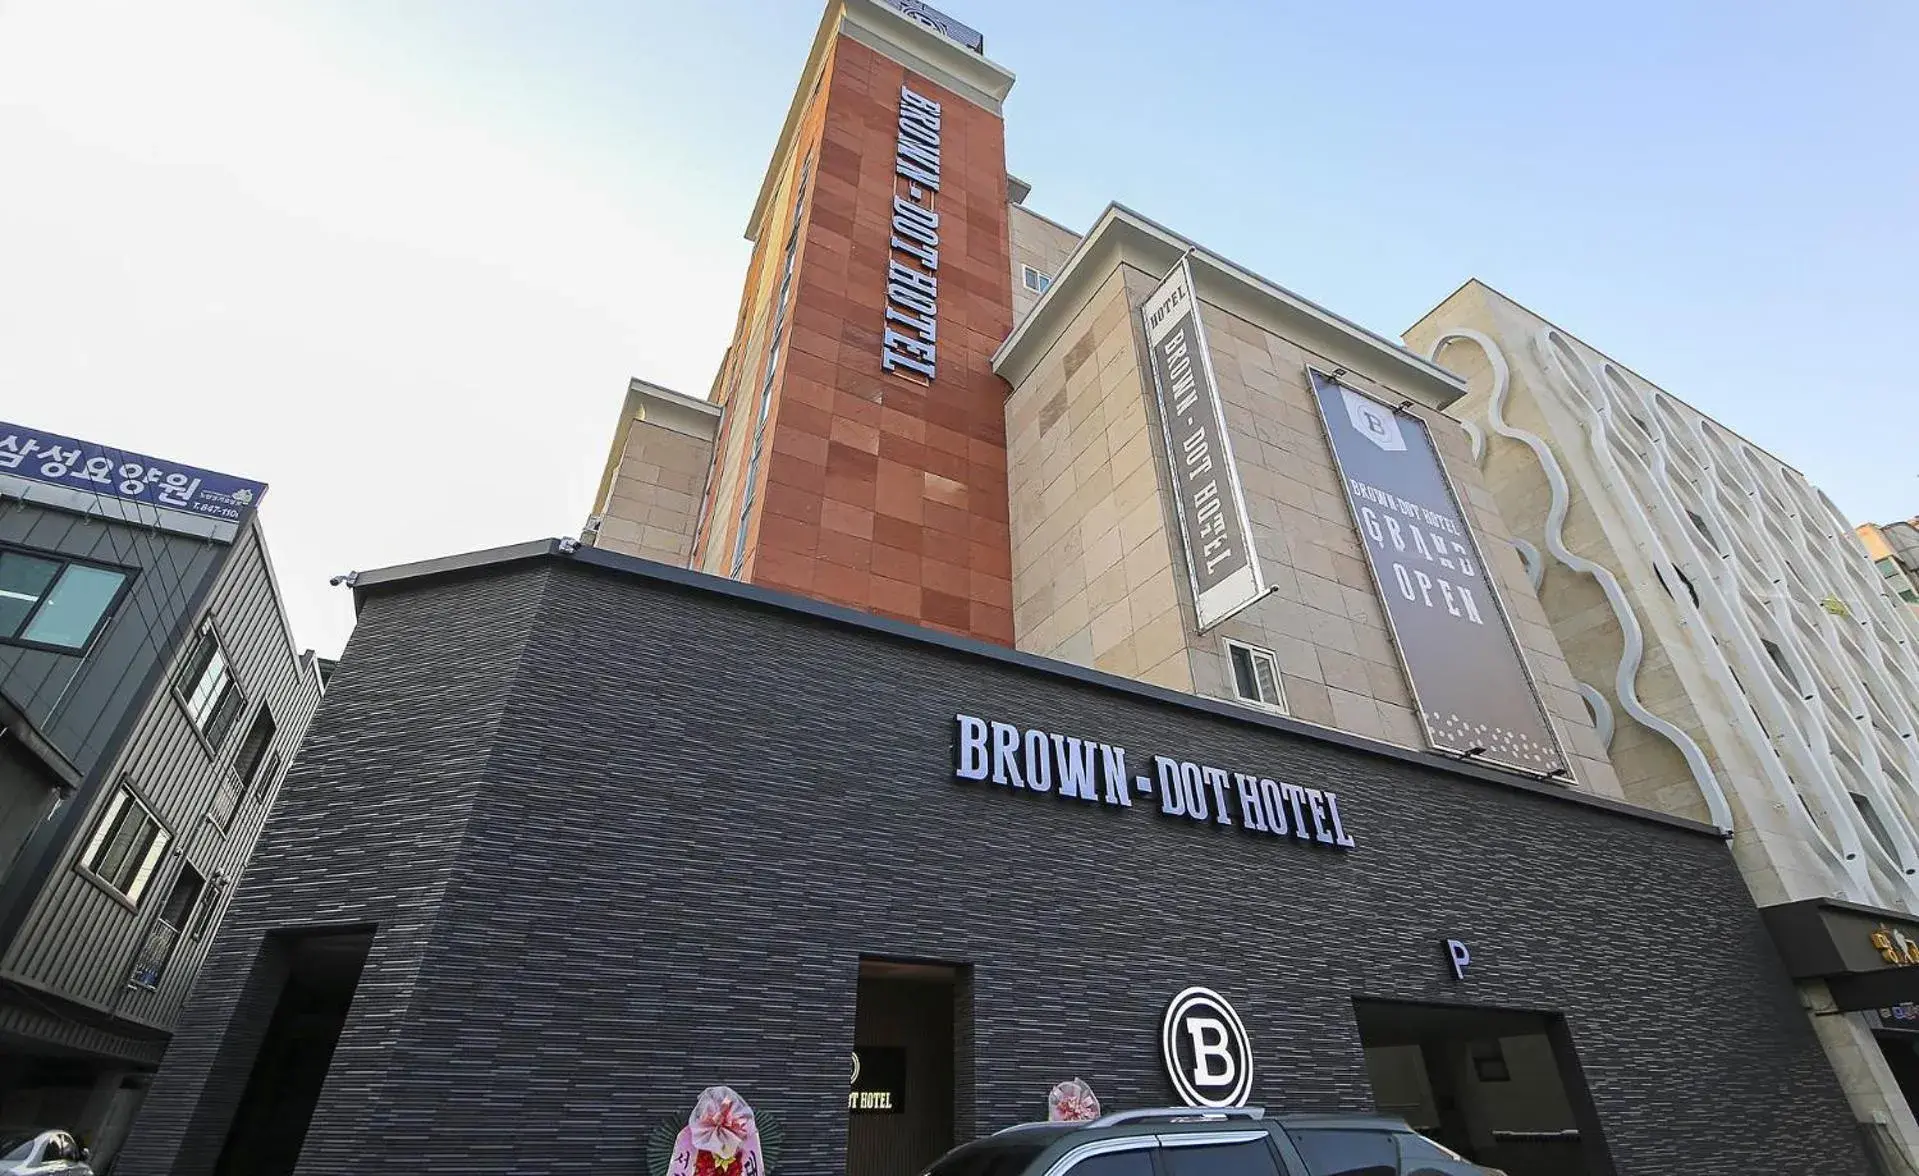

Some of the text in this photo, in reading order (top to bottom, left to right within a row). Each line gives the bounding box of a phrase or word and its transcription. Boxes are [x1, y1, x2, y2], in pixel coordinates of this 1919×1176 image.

[882, 259, 938, 380] HOTEL
[1150, 286, 1186, 329] HOTEL
[0, 435, 201, 506] 삼성요양원
[1194, 479, 1232, 575] HOTEL
[1361, 506, 1475, 577] GRAND
[1421, 508, 1461, 537] HOTEL
[1392, 562, 1483, 625] OPEN
[1232, 772, 1356, 848] HOTEL
[1447, 938, 1471, 980] P
[1186, 1017, 1235, 1086] B
[860, 1092, 892, 1108] HOTEL
